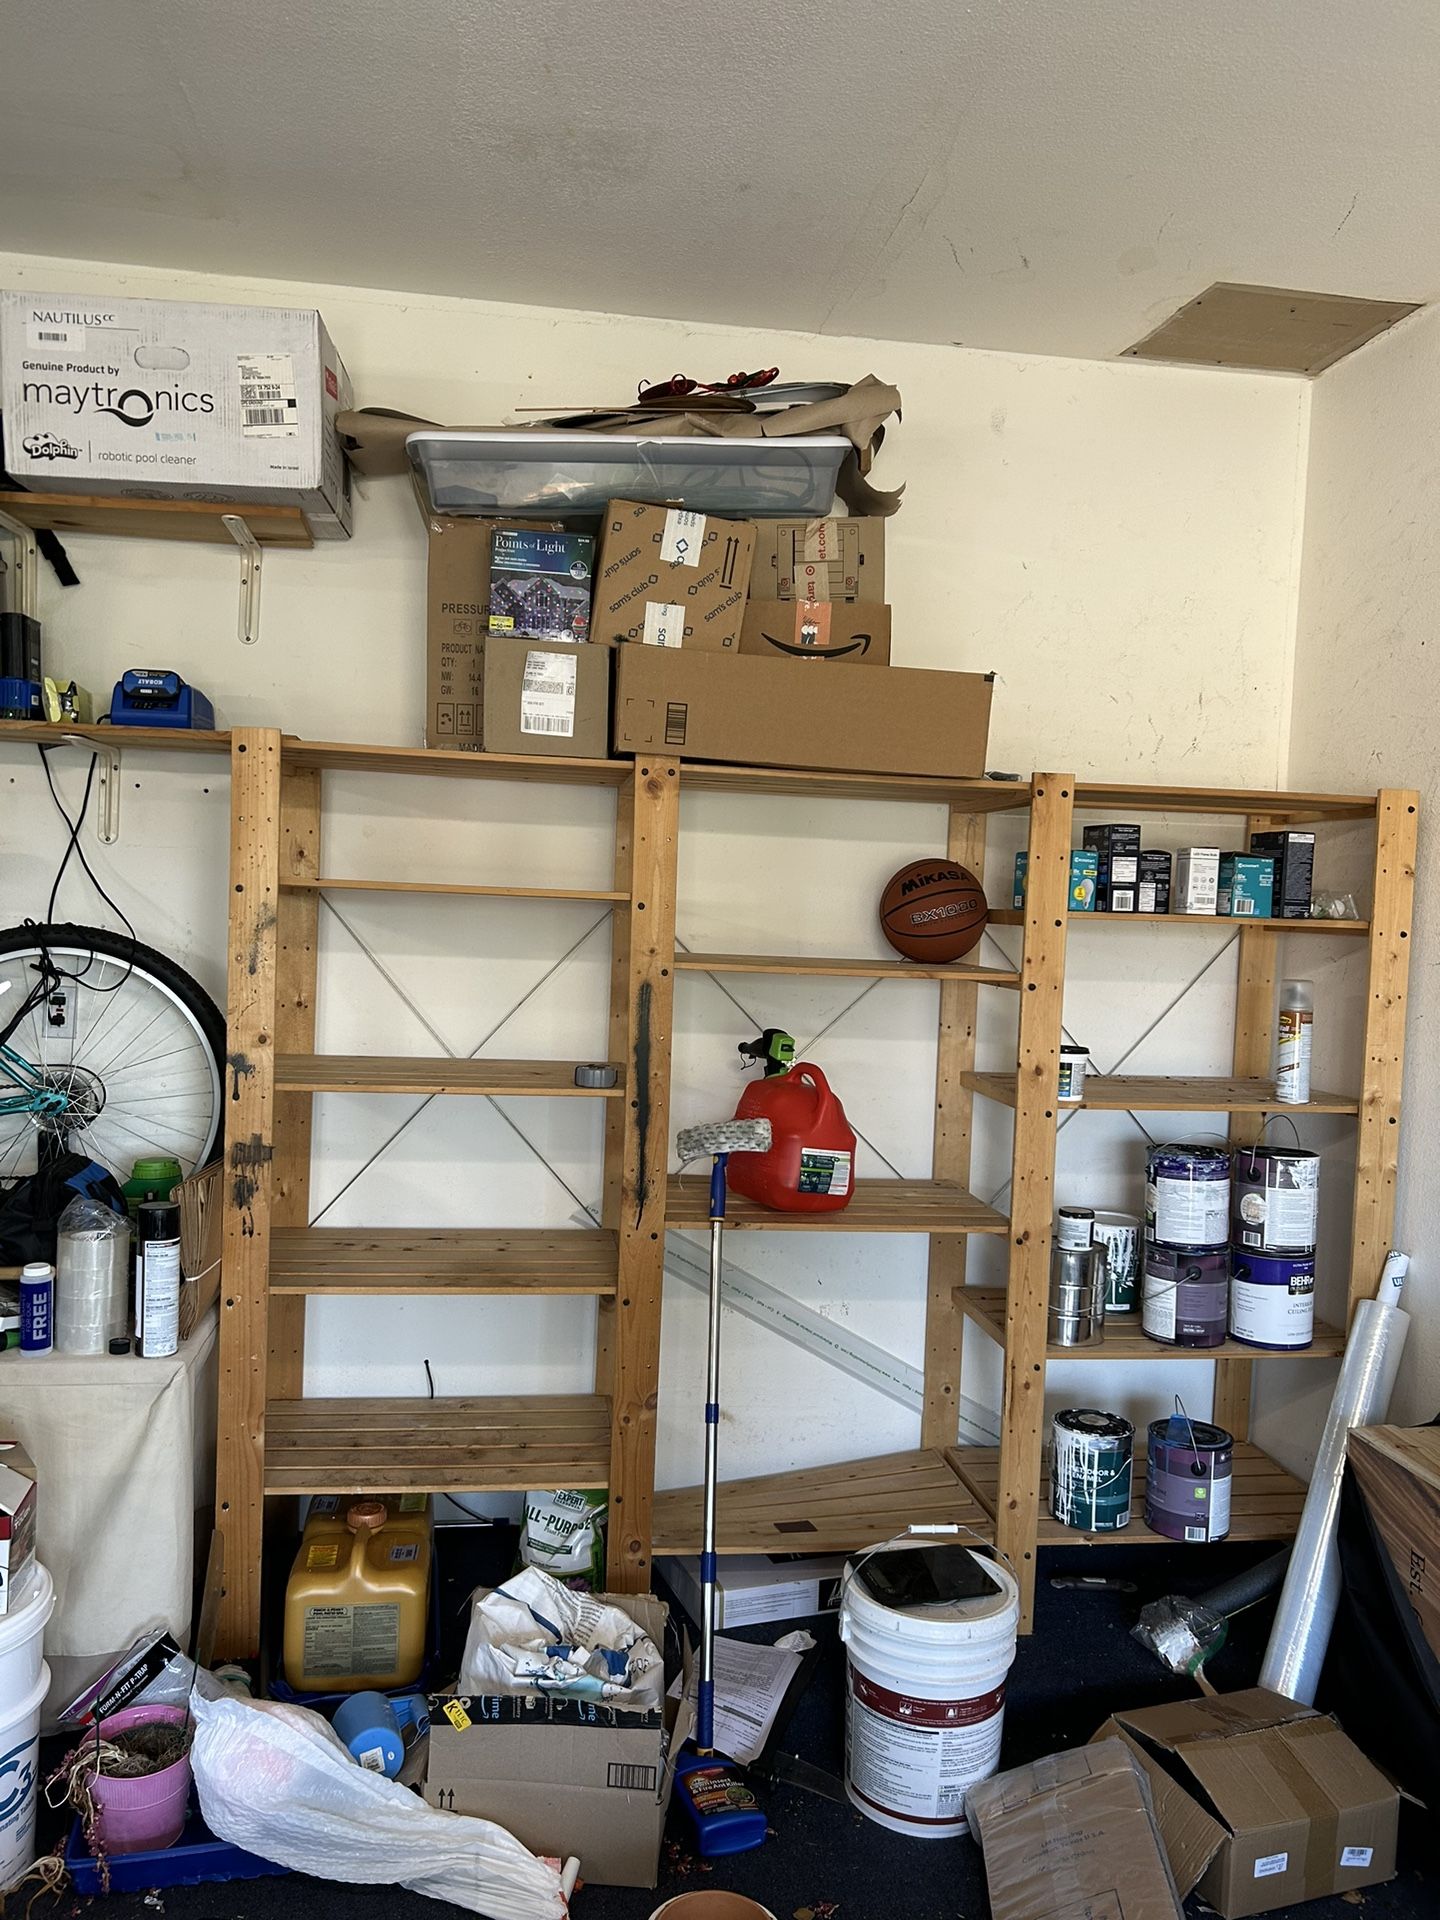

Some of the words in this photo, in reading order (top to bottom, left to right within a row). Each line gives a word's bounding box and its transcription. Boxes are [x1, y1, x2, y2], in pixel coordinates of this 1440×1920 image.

[33, 311, 101, 325] NAUTILUS
[22, 360, 63, 372] Genuine
[66, 363, 105, 374] Product
[107, 364, 119, 376] by
[23, 382, 214, 422] maytronics
[98, 451, 132, 462] robotic
[135, 452, 157, 464] pool
[160, 453, 197, 465] cleaner
[495, 535, 529, 549] Points
[536, 539, 565, 555] Light
[609, 594, 632, 613] sam's
[631, 581, 649, 597] club
[704, 604, 727, 623] sam's
[726, 591, 743, 606] club
[441, 642, 472, 654] PRODUCT
[441, 657, 457, 668] QTY:
[472, 659, 476, 669] 1
[440, 671, 455, 681] NW:
[440, 685, 455, 695] GW:
[1290, 1275, 1310, 1287] BEHR
[33, 1292, 47, 1340] FREE
[557, 1491, 584, 1506] EXPERT
[99, 1681, 132, 1714] FORM-N-FIT
[130, 1663, 149, 1685] P-TRAP
[698, 1785, 713, 1793] Fire
